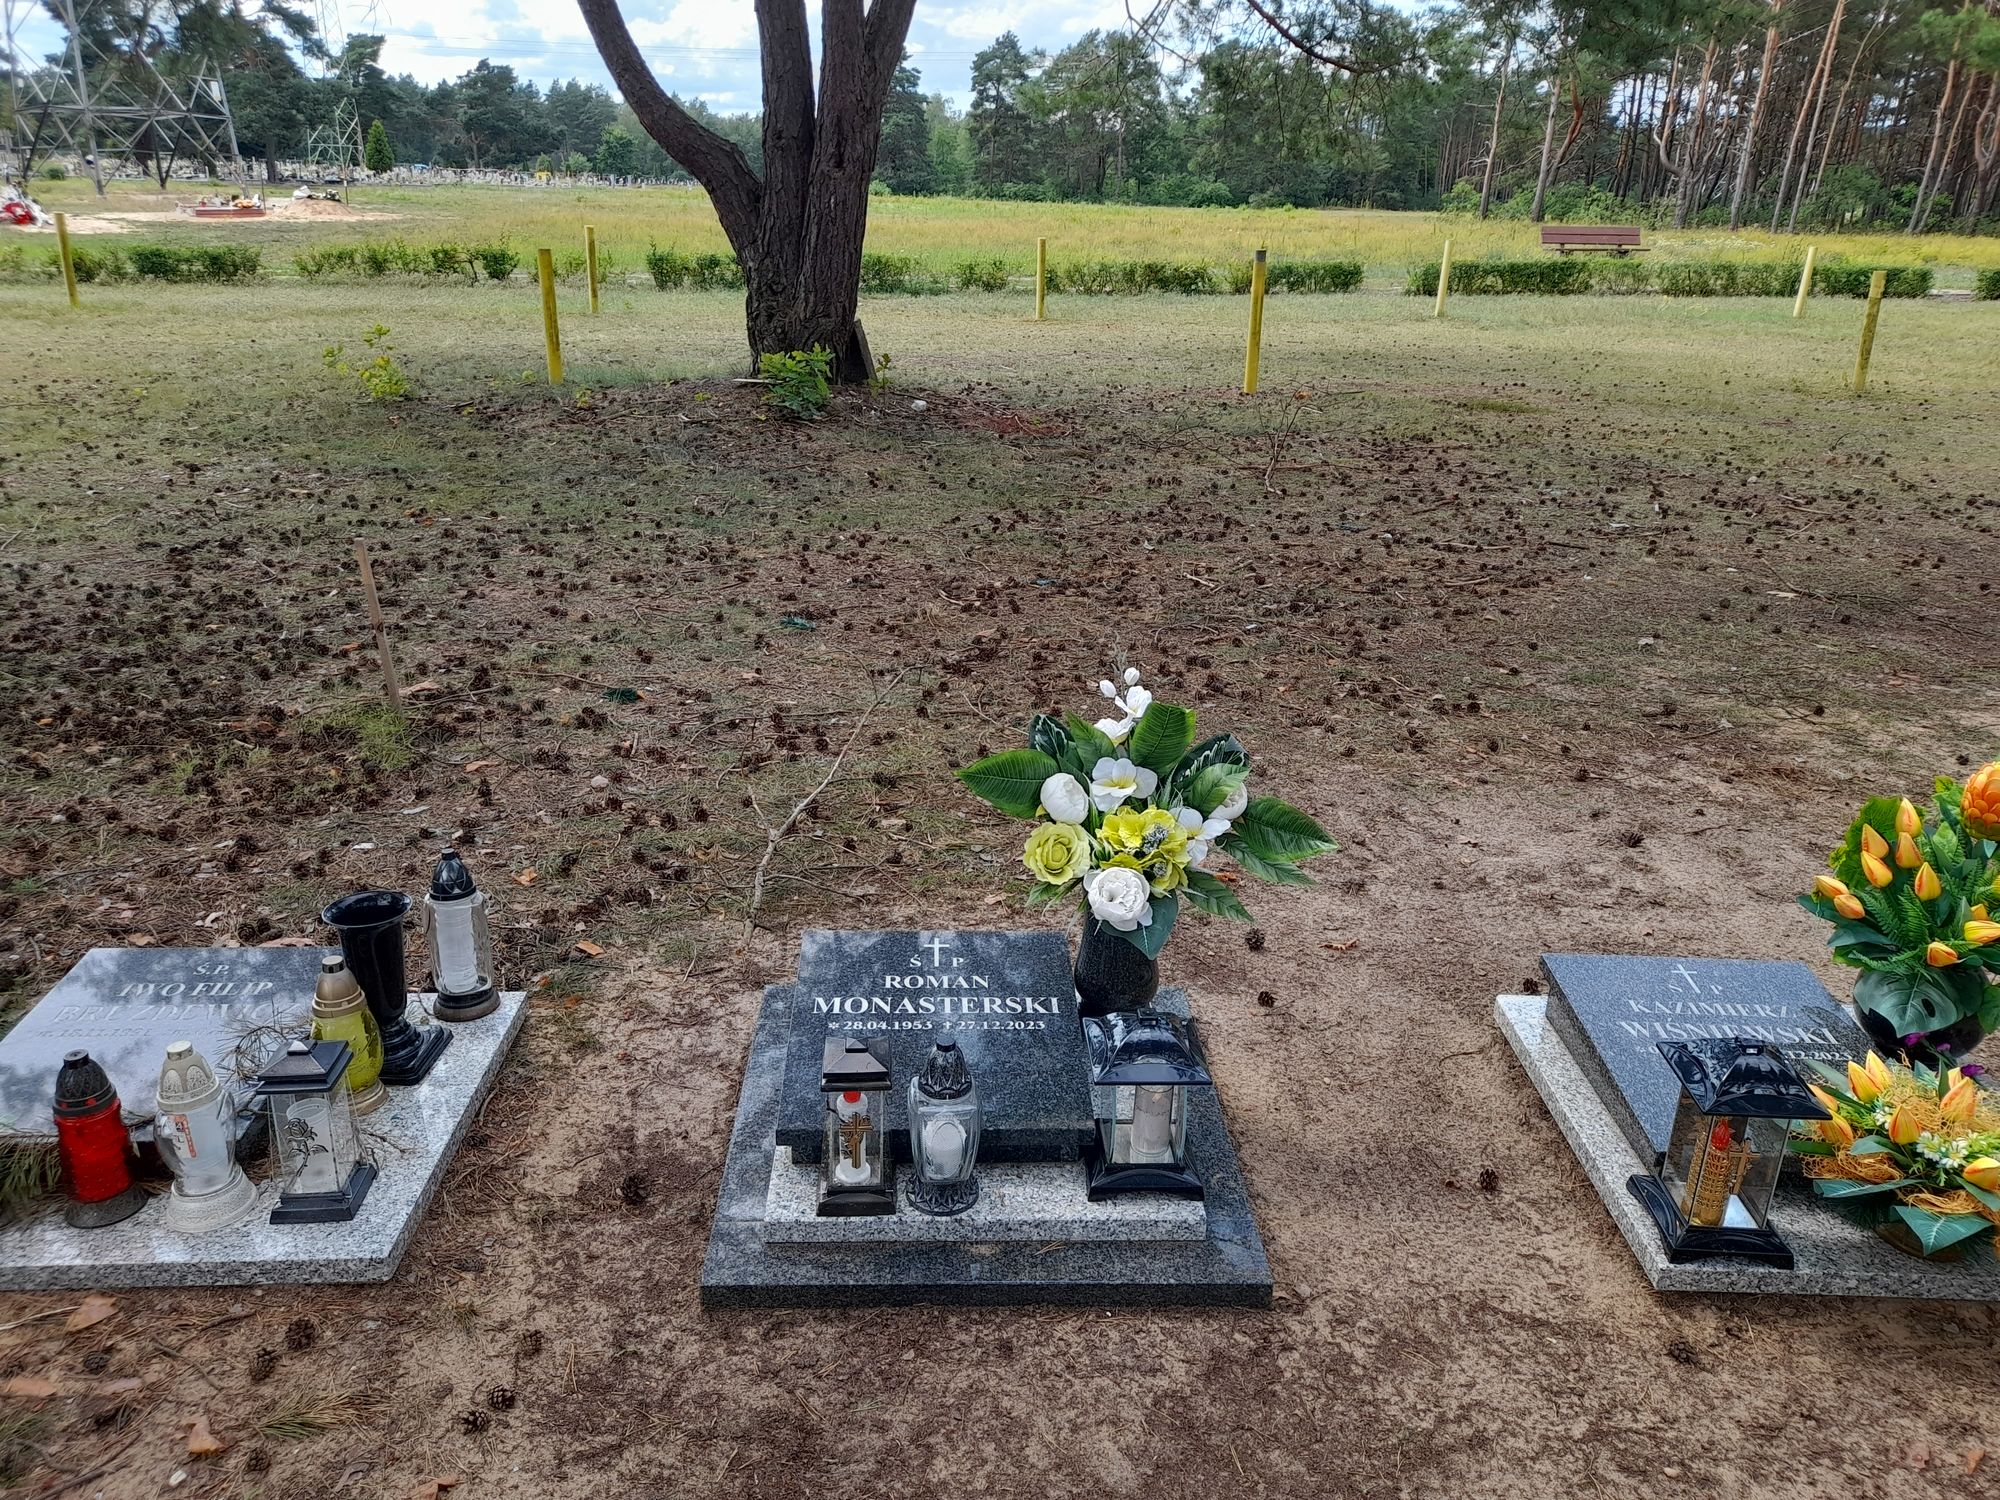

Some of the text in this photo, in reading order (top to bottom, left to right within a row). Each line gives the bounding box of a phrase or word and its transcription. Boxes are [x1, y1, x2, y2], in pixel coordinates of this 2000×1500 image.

[118, 981, 274, 997] IWO FILIP
[884, 974, 990, 989] ROMAN
[812, 996, 1061, 1015] MONASTERSKI
[843, 1020, 1046, 1031] 28.04.1953 27.12.2023
[1616, 1017, 1841, 1045] WIŚNIEWSKI
